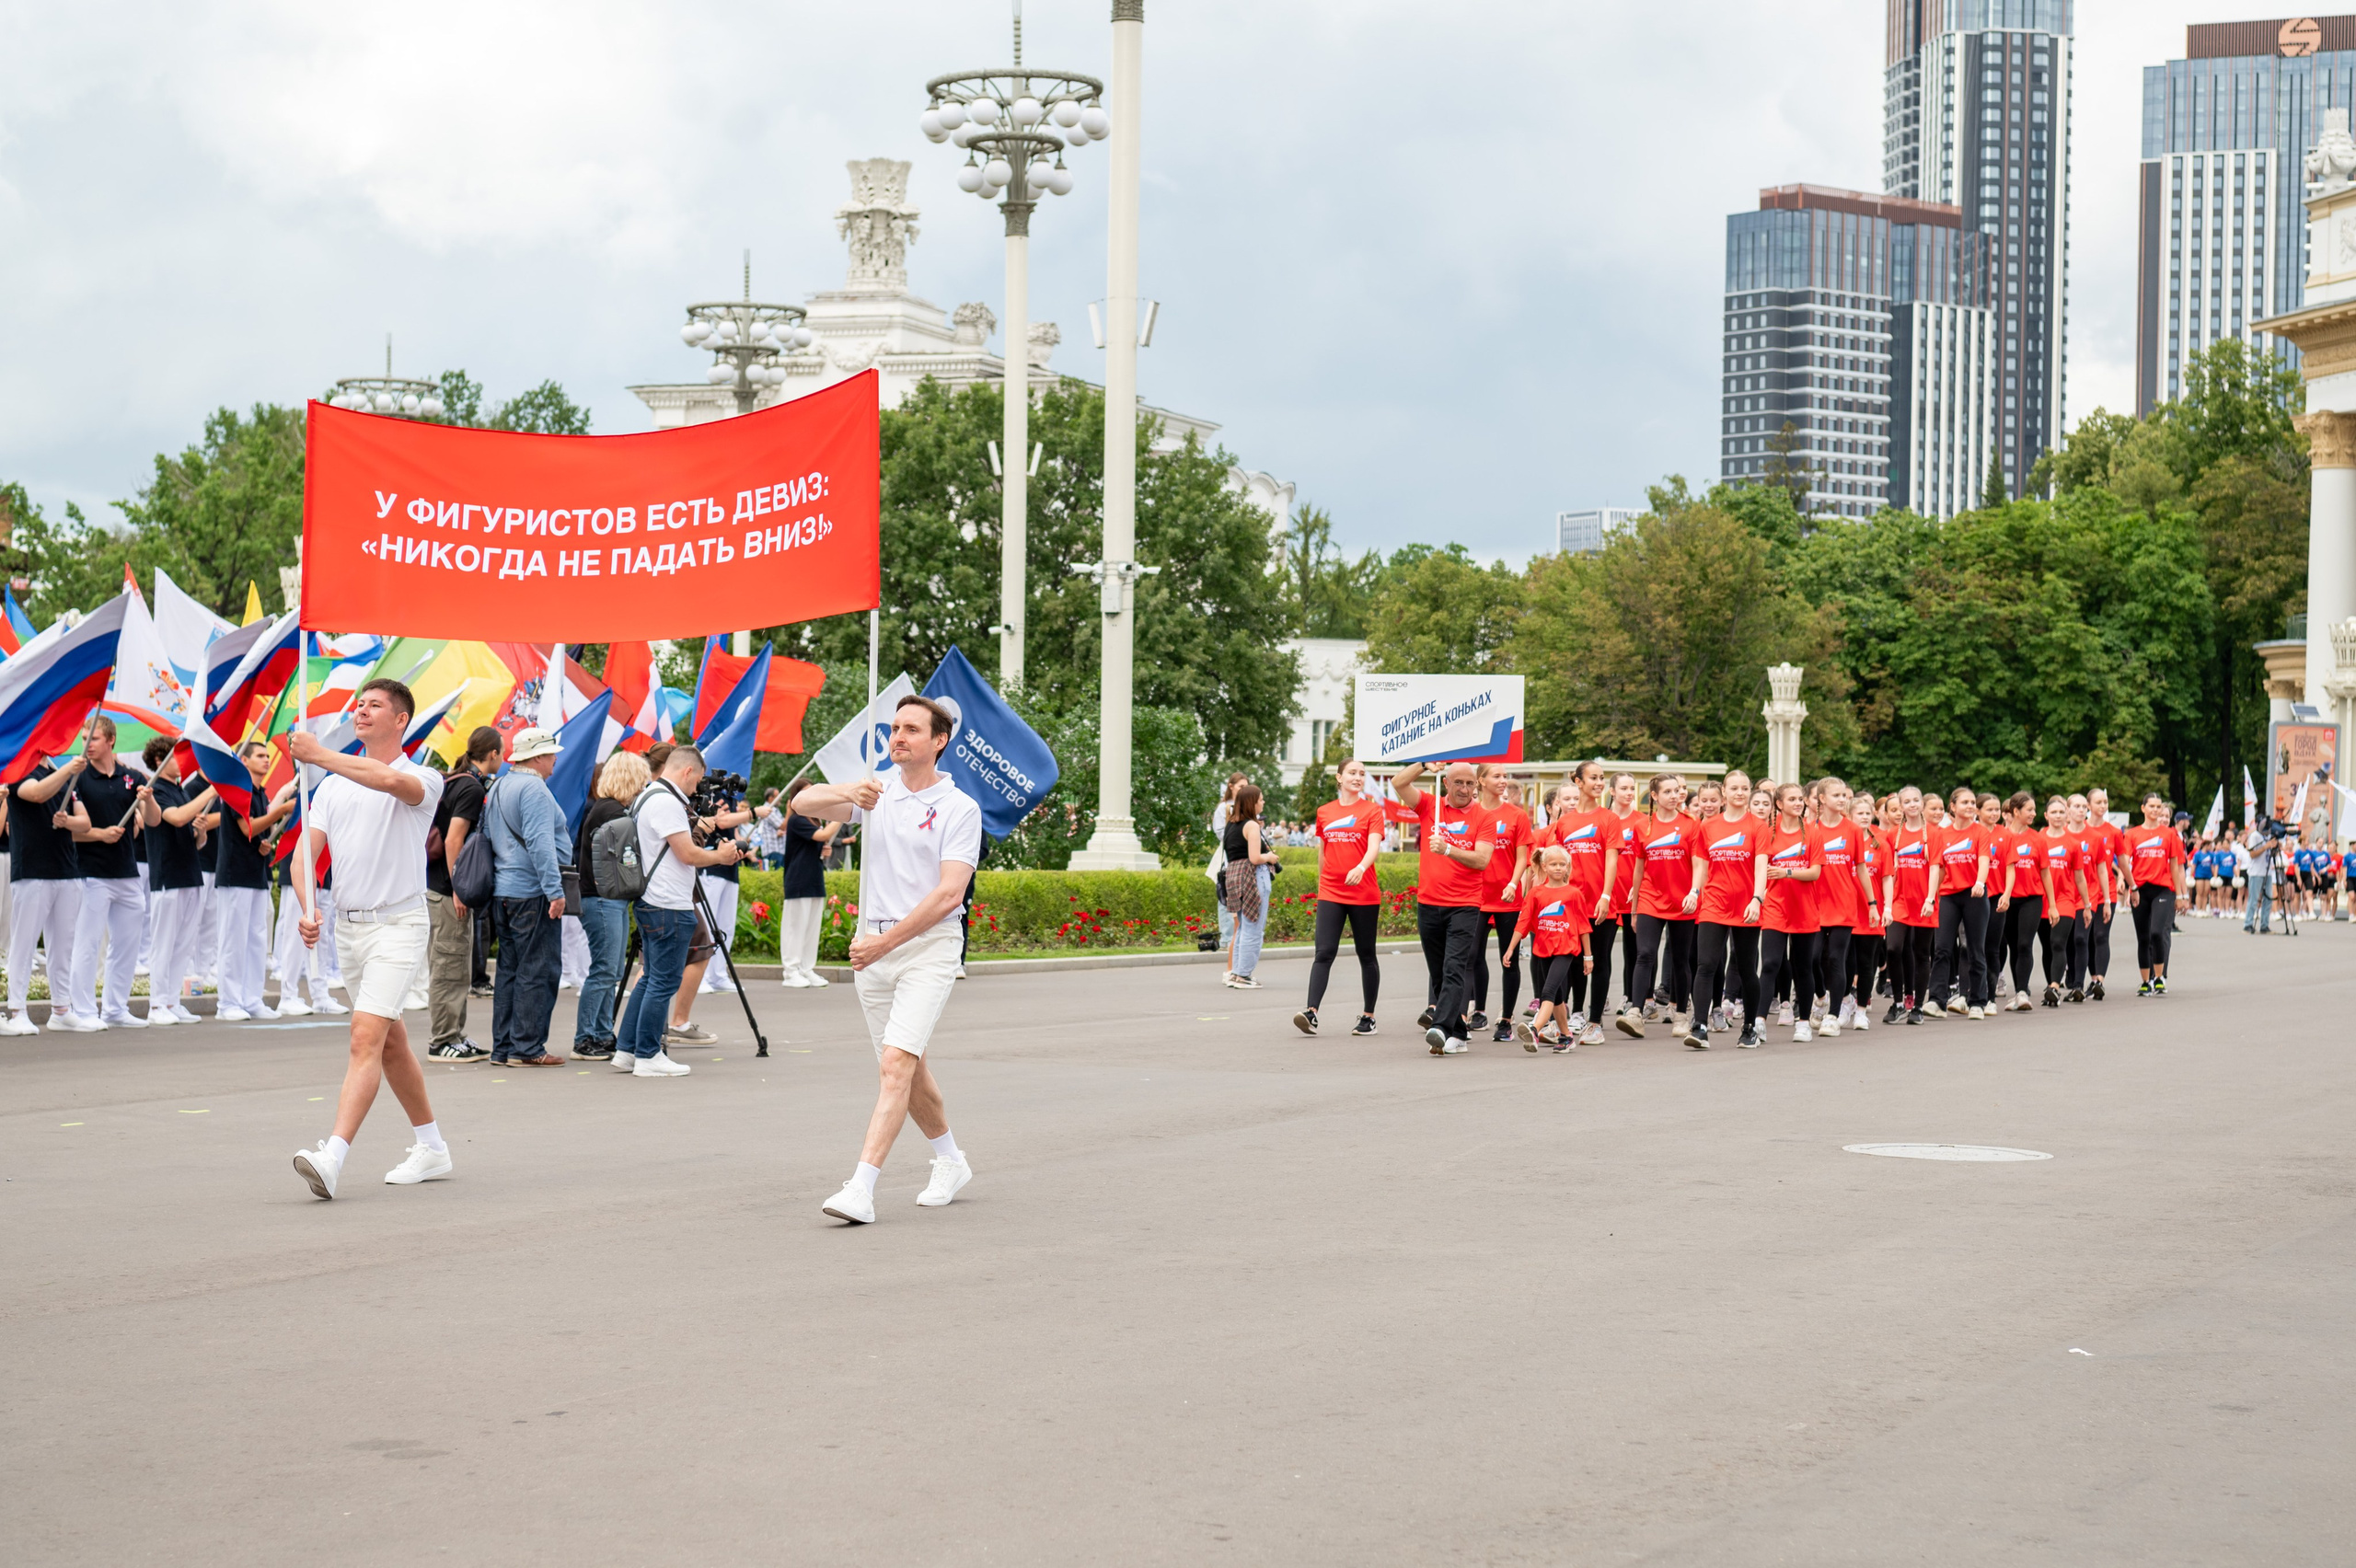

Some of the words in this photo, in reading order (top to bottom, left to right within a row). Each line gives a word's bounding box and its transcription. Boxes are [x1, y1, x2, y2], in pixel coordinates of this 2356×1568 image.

[375, 490, 398, 519] У
[407, 497, 637, 536] ФИГУРИСТОВ
[646, 497, 725, 532] ЕСТЬ
[732, 471, 829, 525] ДЕВИЗ:
[361, 533, 548, 582] «НИКОГДА
[558, 549, 602, 577] НЕ
[610, 536, 735, 577] ПАДАТЬ
[743, 513, 833, 559] ВНИЗ!»
[1381, 699, 1437, 737] ФИГУРНОЕ
[1381, 722, 1426, 756] КАТАНИЕ
[1428, 715, 1442, 733] НА
[1444, 689, 1492, 725] КОНЬКАХ
[955, 744, 1026, 808] ОТЕЧЕСТВО
[964, 729, 1035, 793] ЗДОРОВОЕ
